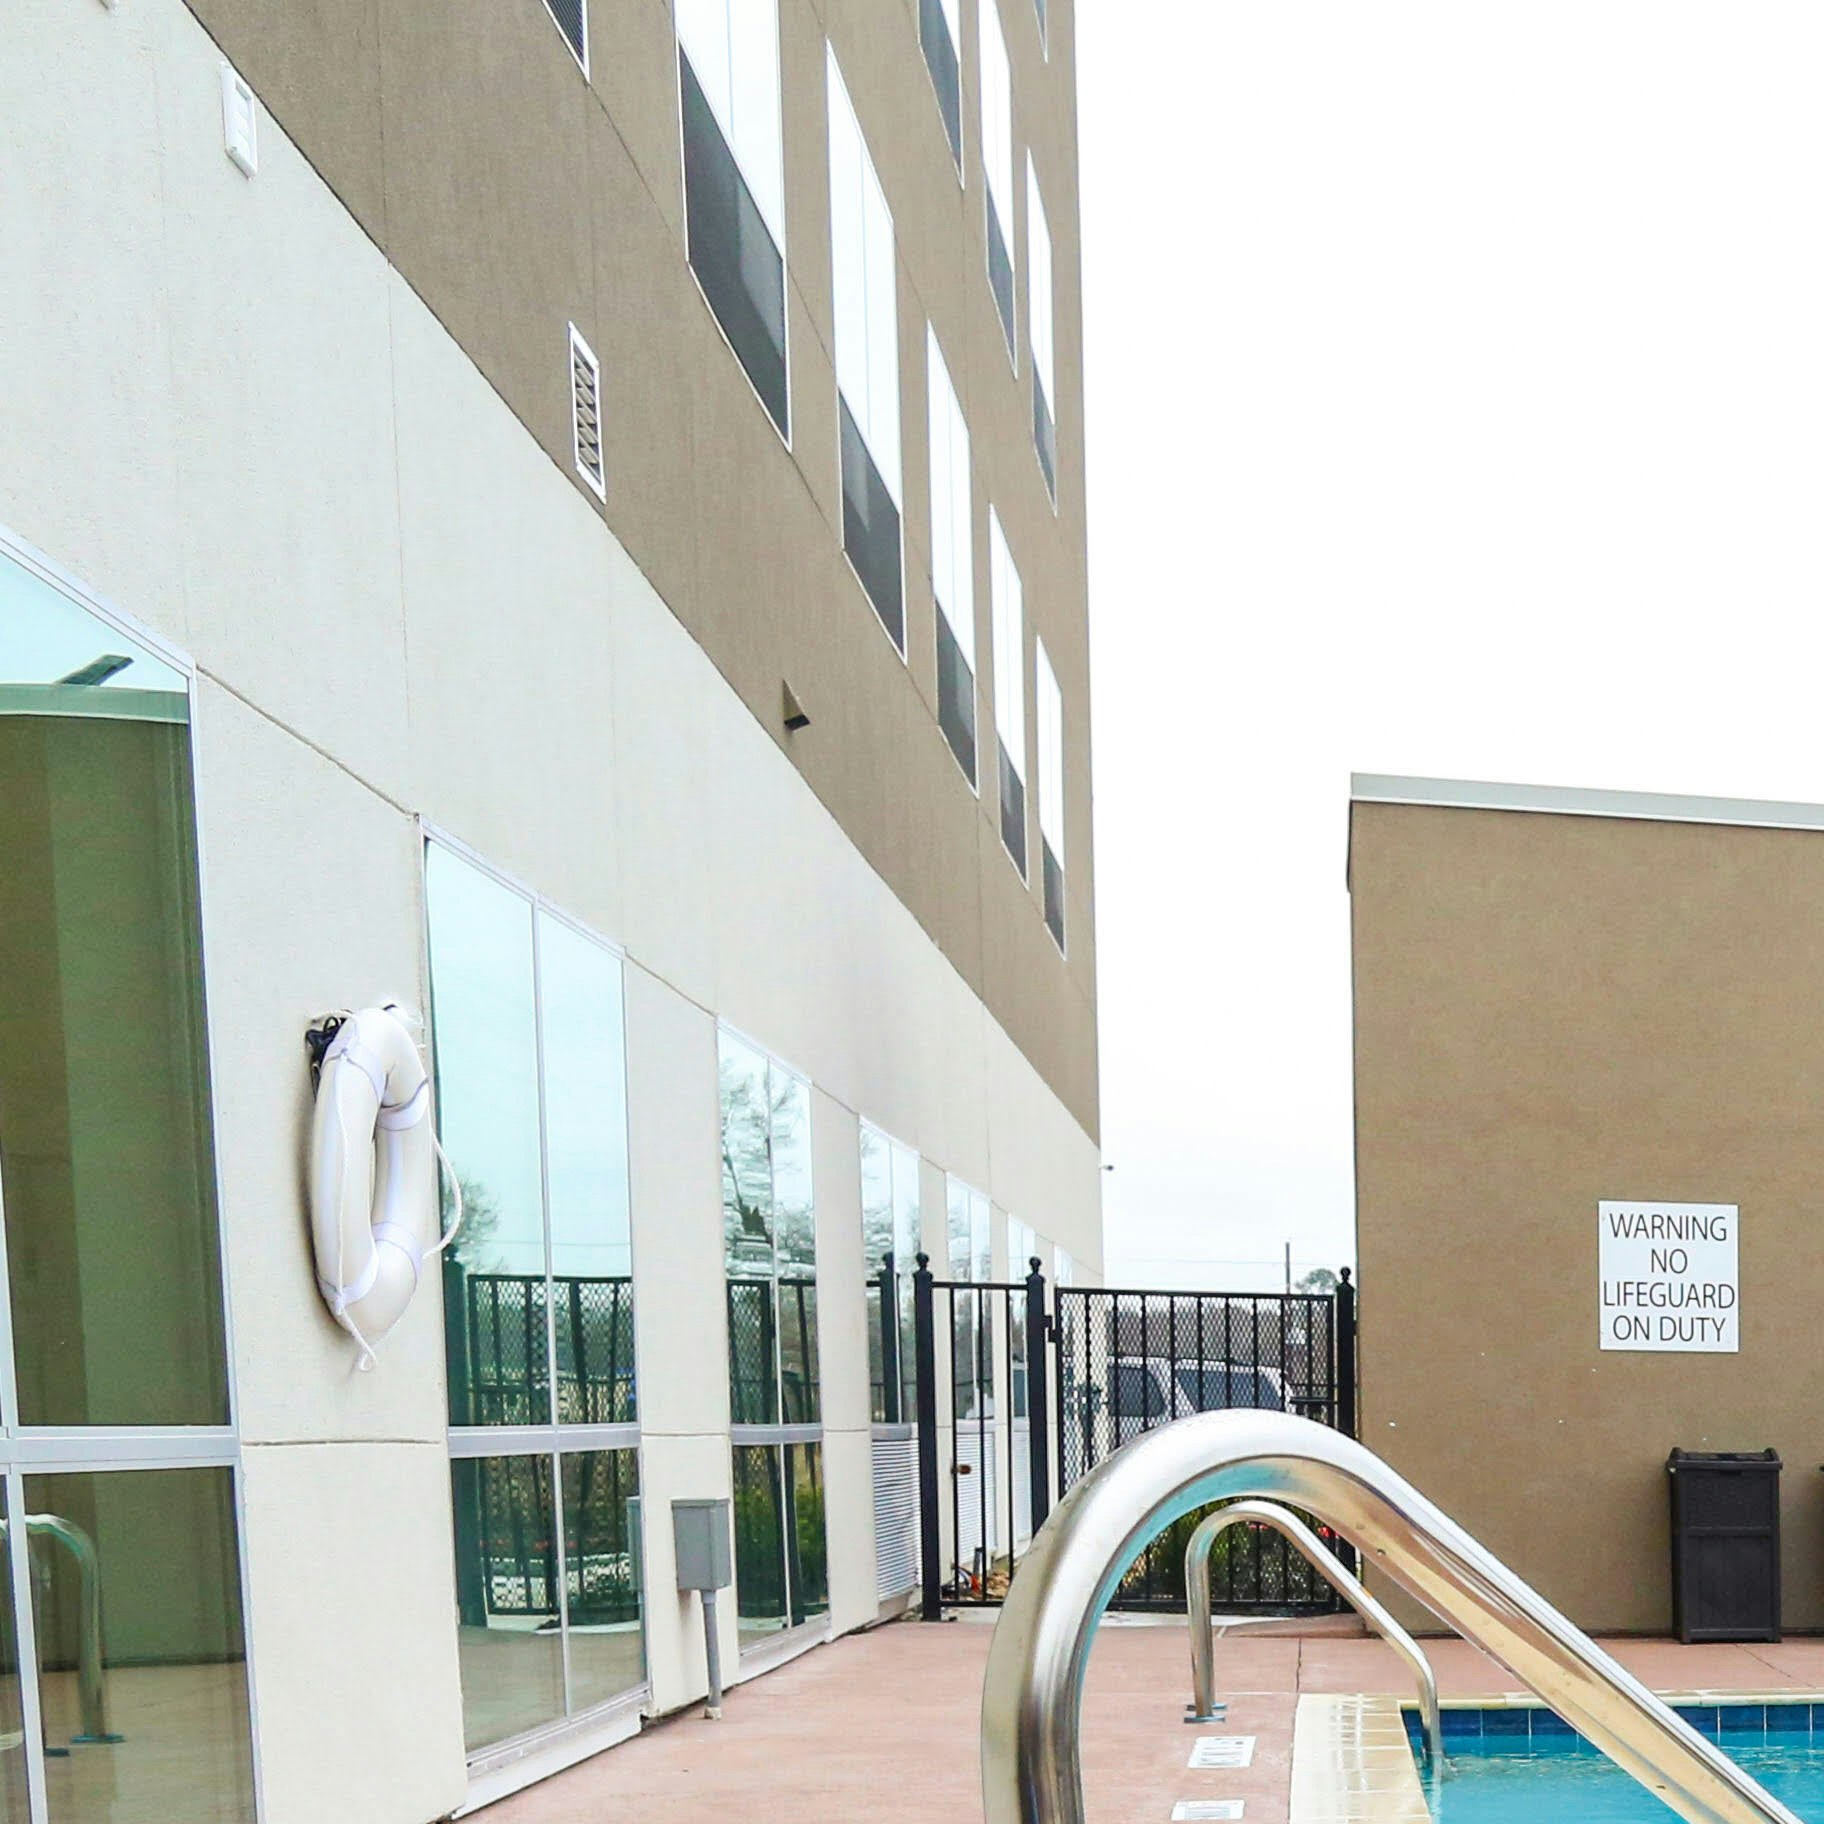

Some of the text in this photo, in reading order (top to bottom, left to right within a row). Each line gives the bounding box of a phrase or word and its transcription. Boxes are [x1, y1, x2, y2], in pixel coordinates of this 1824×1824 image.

[1609, 1212, 1727, 1242] WARNING
[1650, 1247, 1689, 1275] NO
[1603, 1280, 1736, 1309] LIFEGUARD
[1612, 1314, 1727, 1343] ON DUTY
